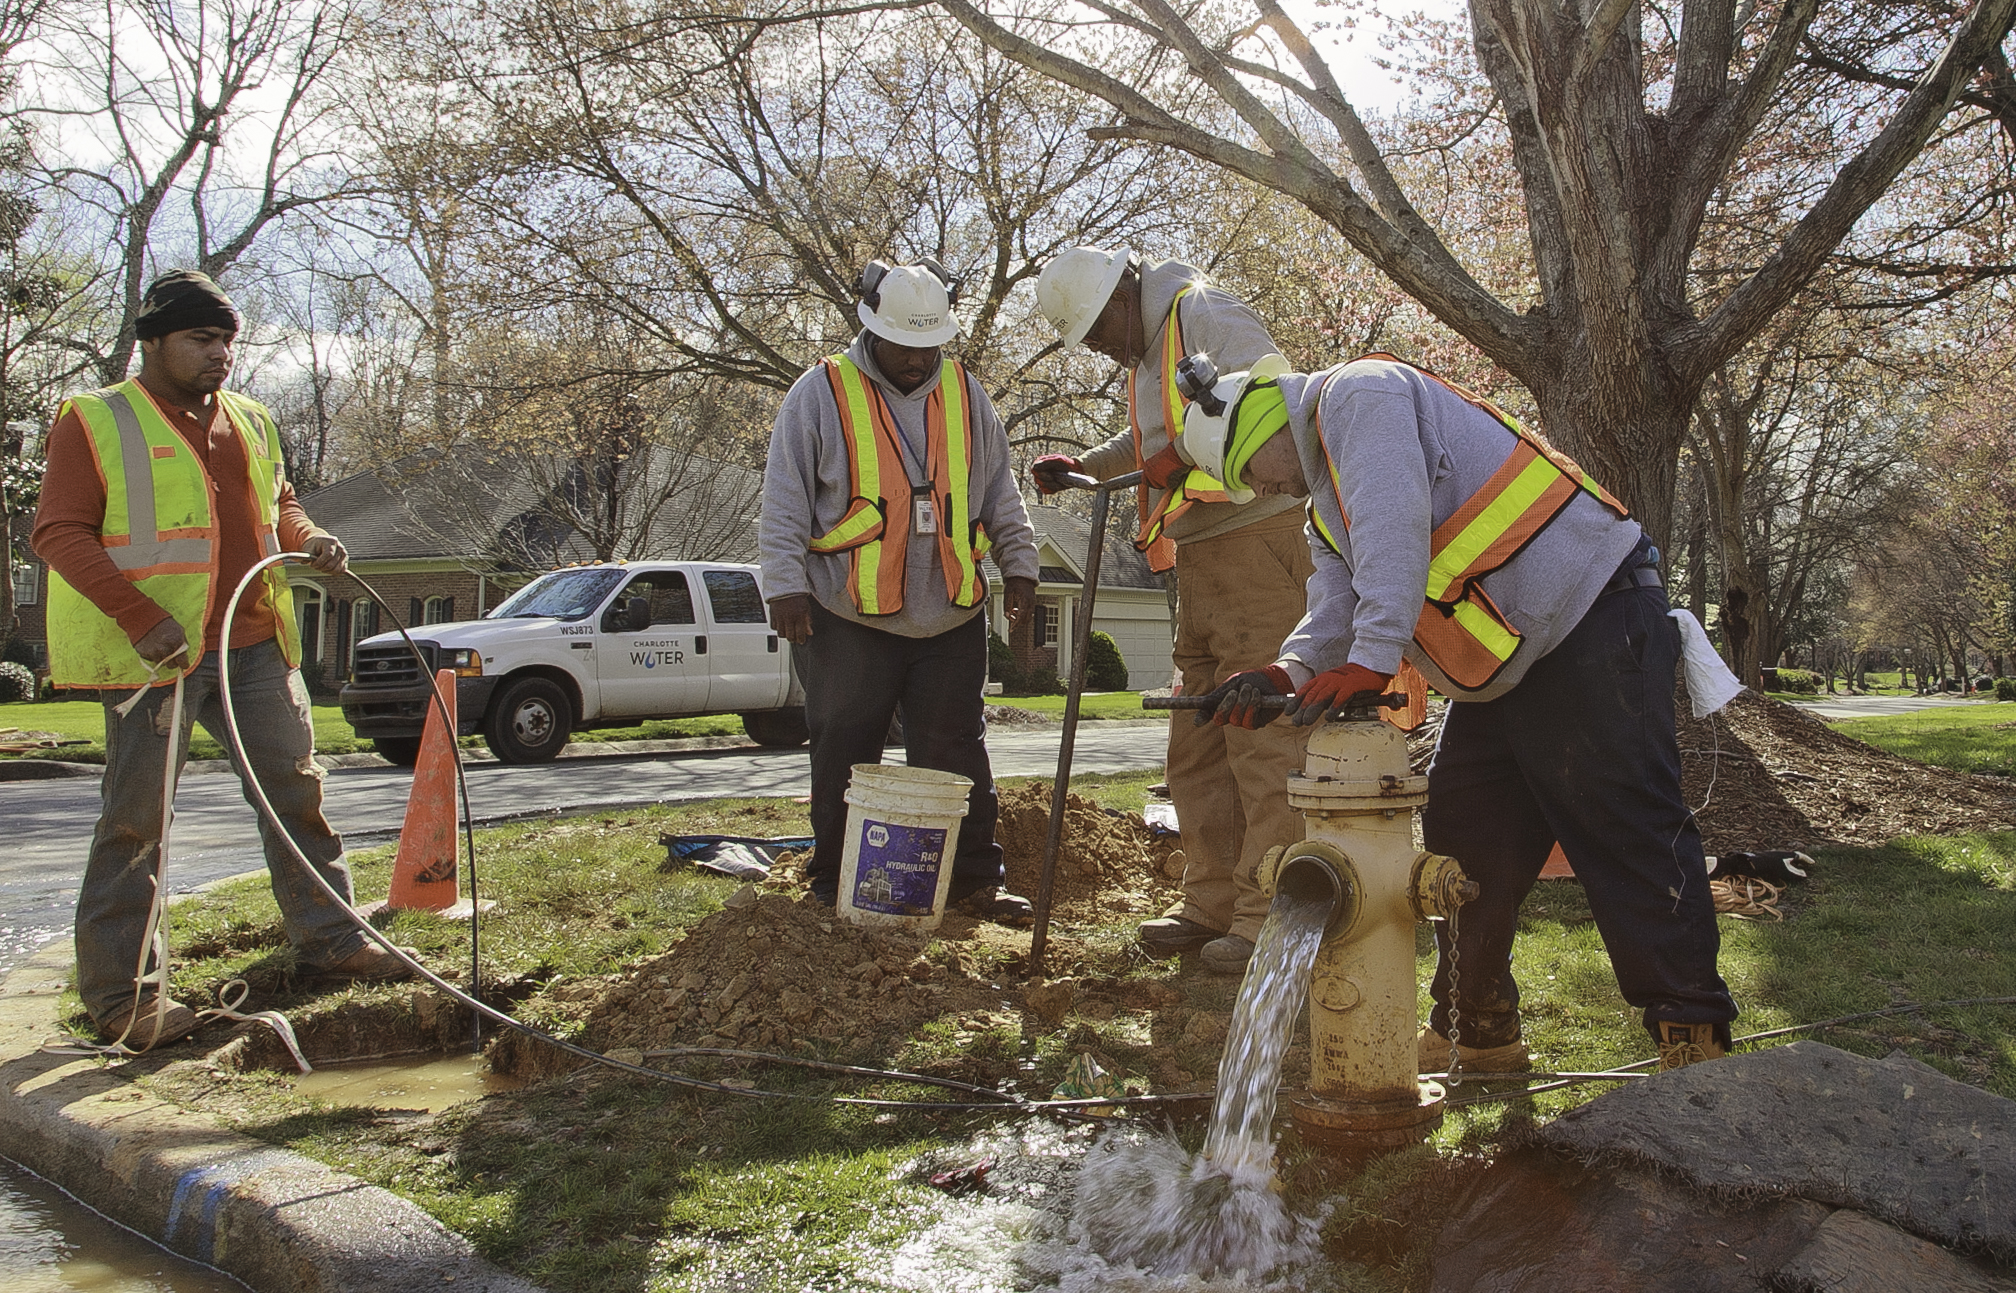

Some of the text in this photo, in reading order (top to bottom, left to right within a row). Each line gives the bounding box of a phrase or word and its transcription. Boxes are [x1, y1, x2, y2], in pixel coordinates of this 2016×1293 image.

[560, 625, 594, 635] WSJ873
[870, 830, 886, 843] NAPA
[920, 852, 938, 862] R&O
[885, 860, 936, 872] HYDRAULIC OIL
